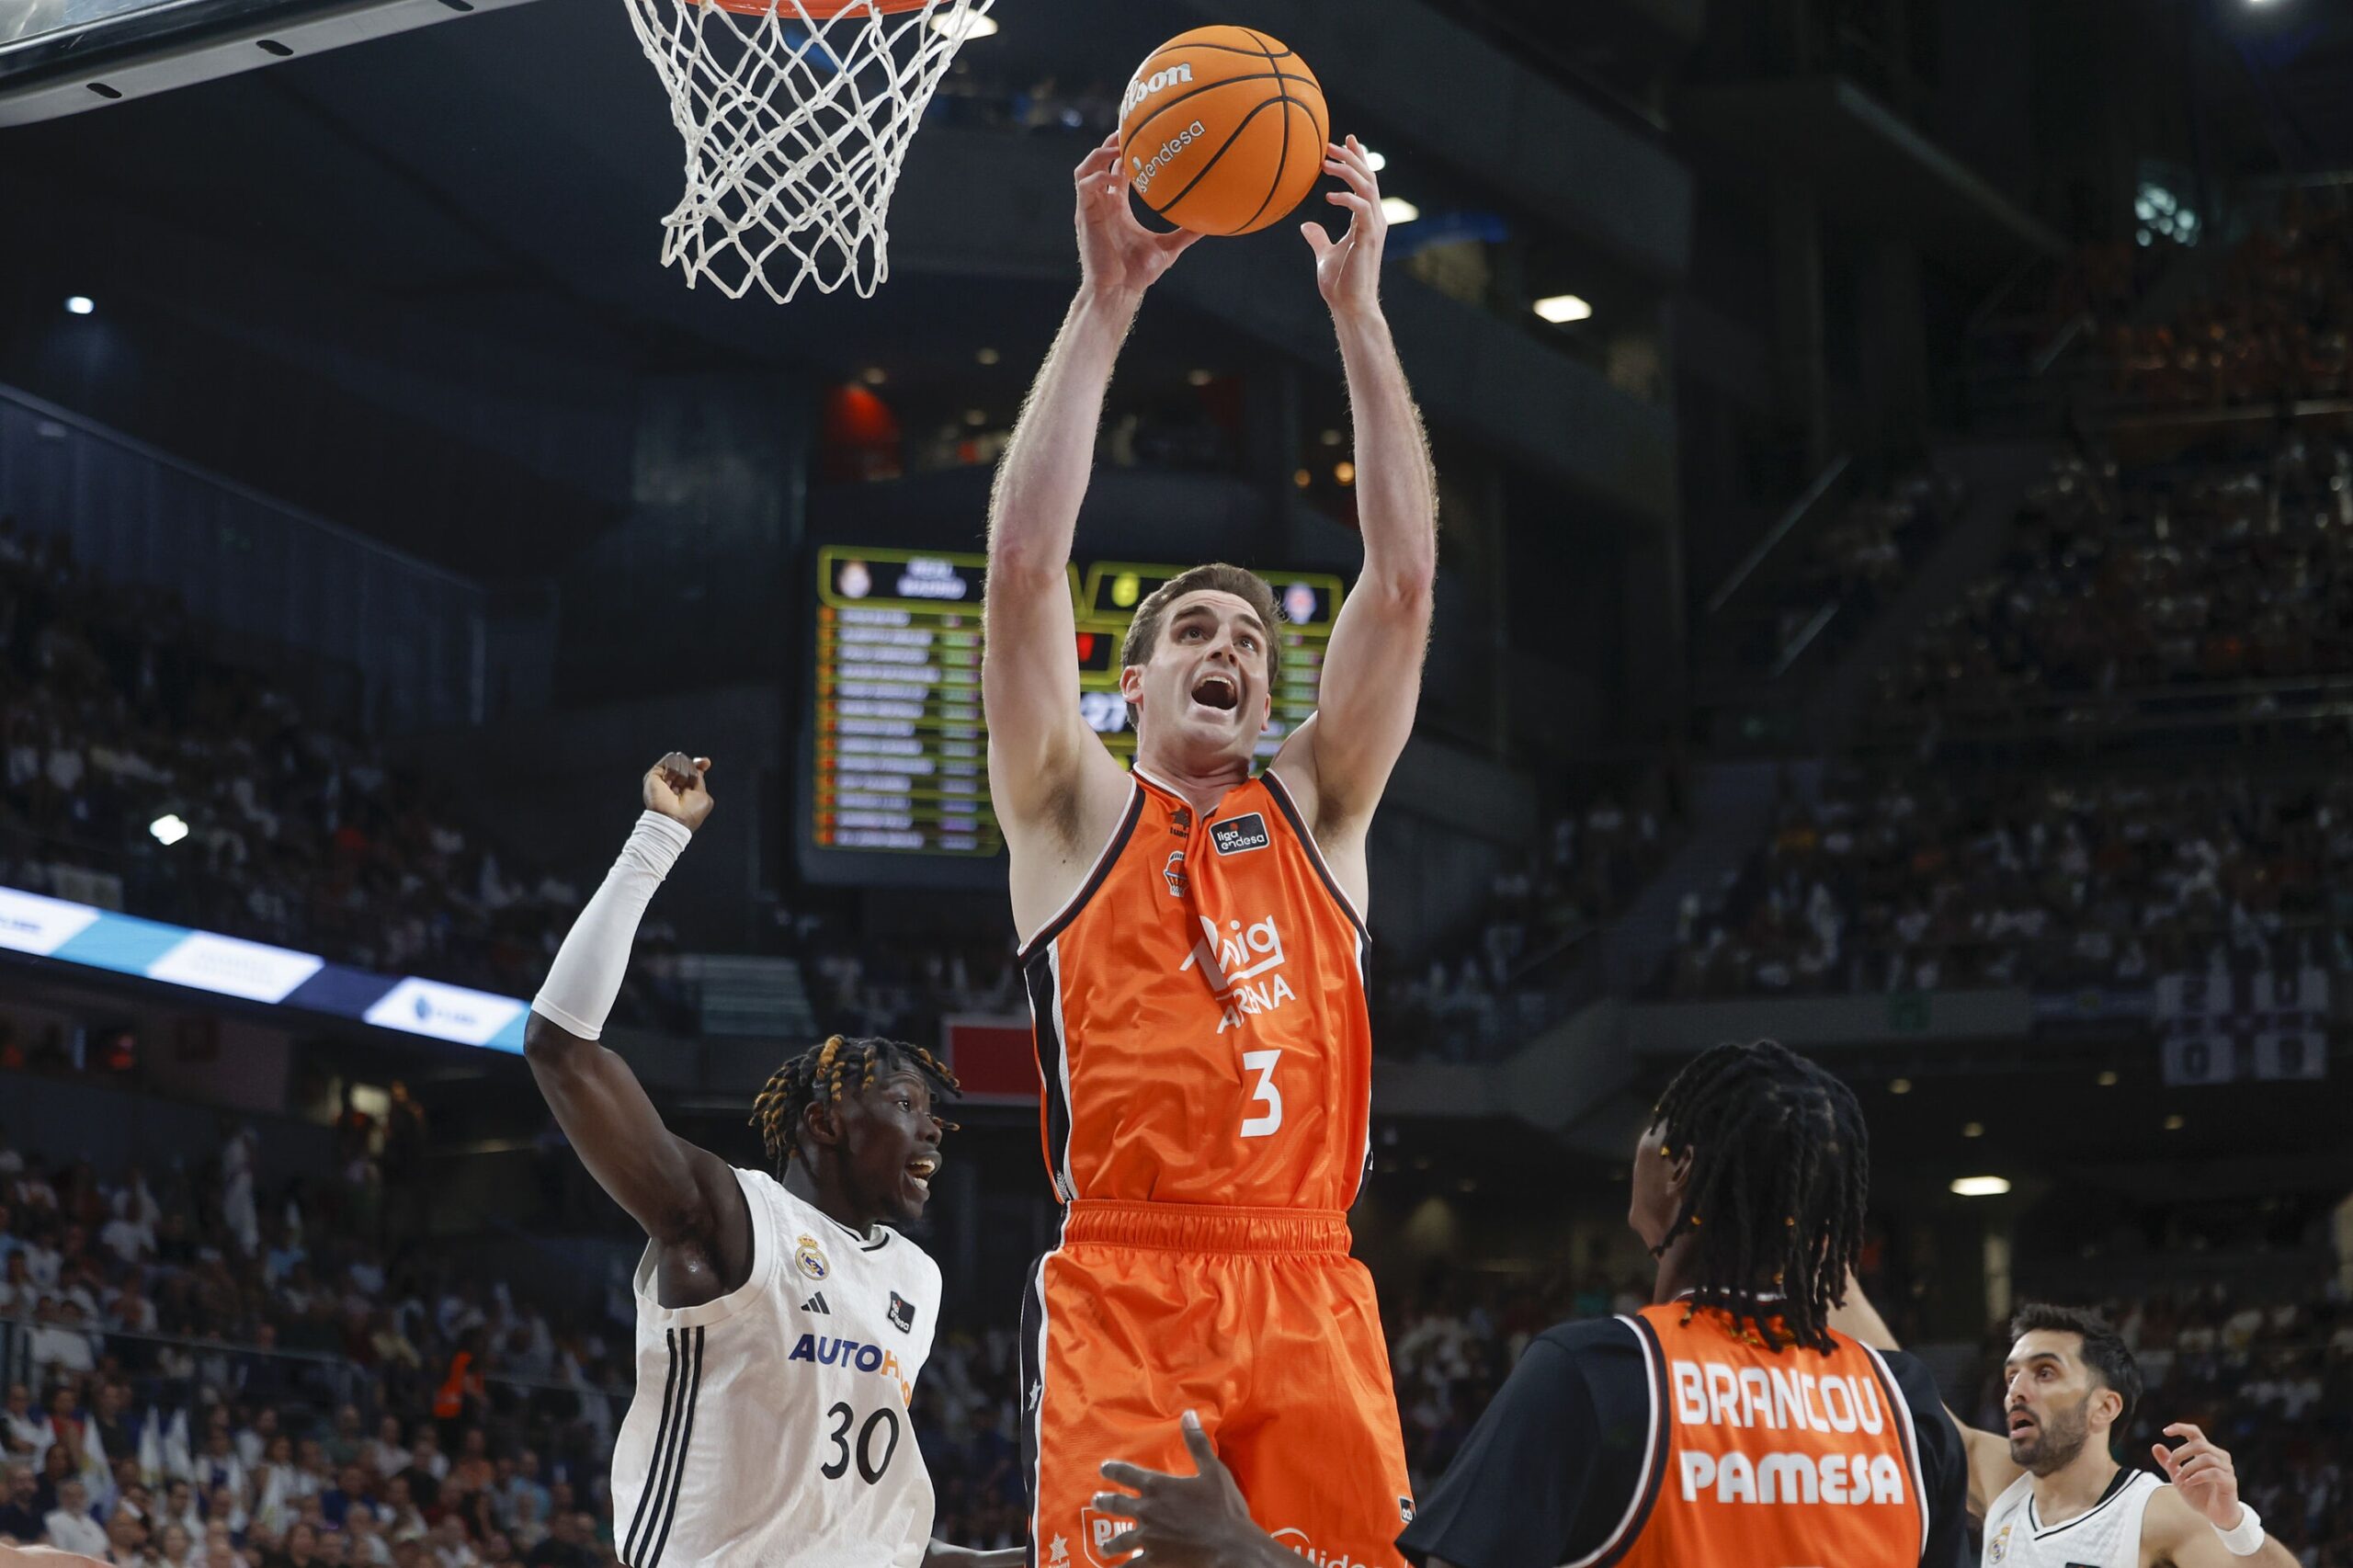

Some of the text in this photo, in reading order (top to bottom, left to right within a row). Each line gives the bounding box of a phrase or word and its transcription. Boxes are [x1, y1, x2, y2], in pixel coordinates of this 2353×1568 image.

[1120, 62, 1193, 123] ilson
[1145, 120, 1206, 177] endesa
[1217, 830, 1239, 842] liga
[1221, 833, 1265, 850] endesa
[1239, 1049, 1282, 1138] 3
[1671, 1360, 1884, 1436] BRANCOU
[821, 1401, 900, 1485] 30
[1678, 1449, 1905, 1506] PAMESA
